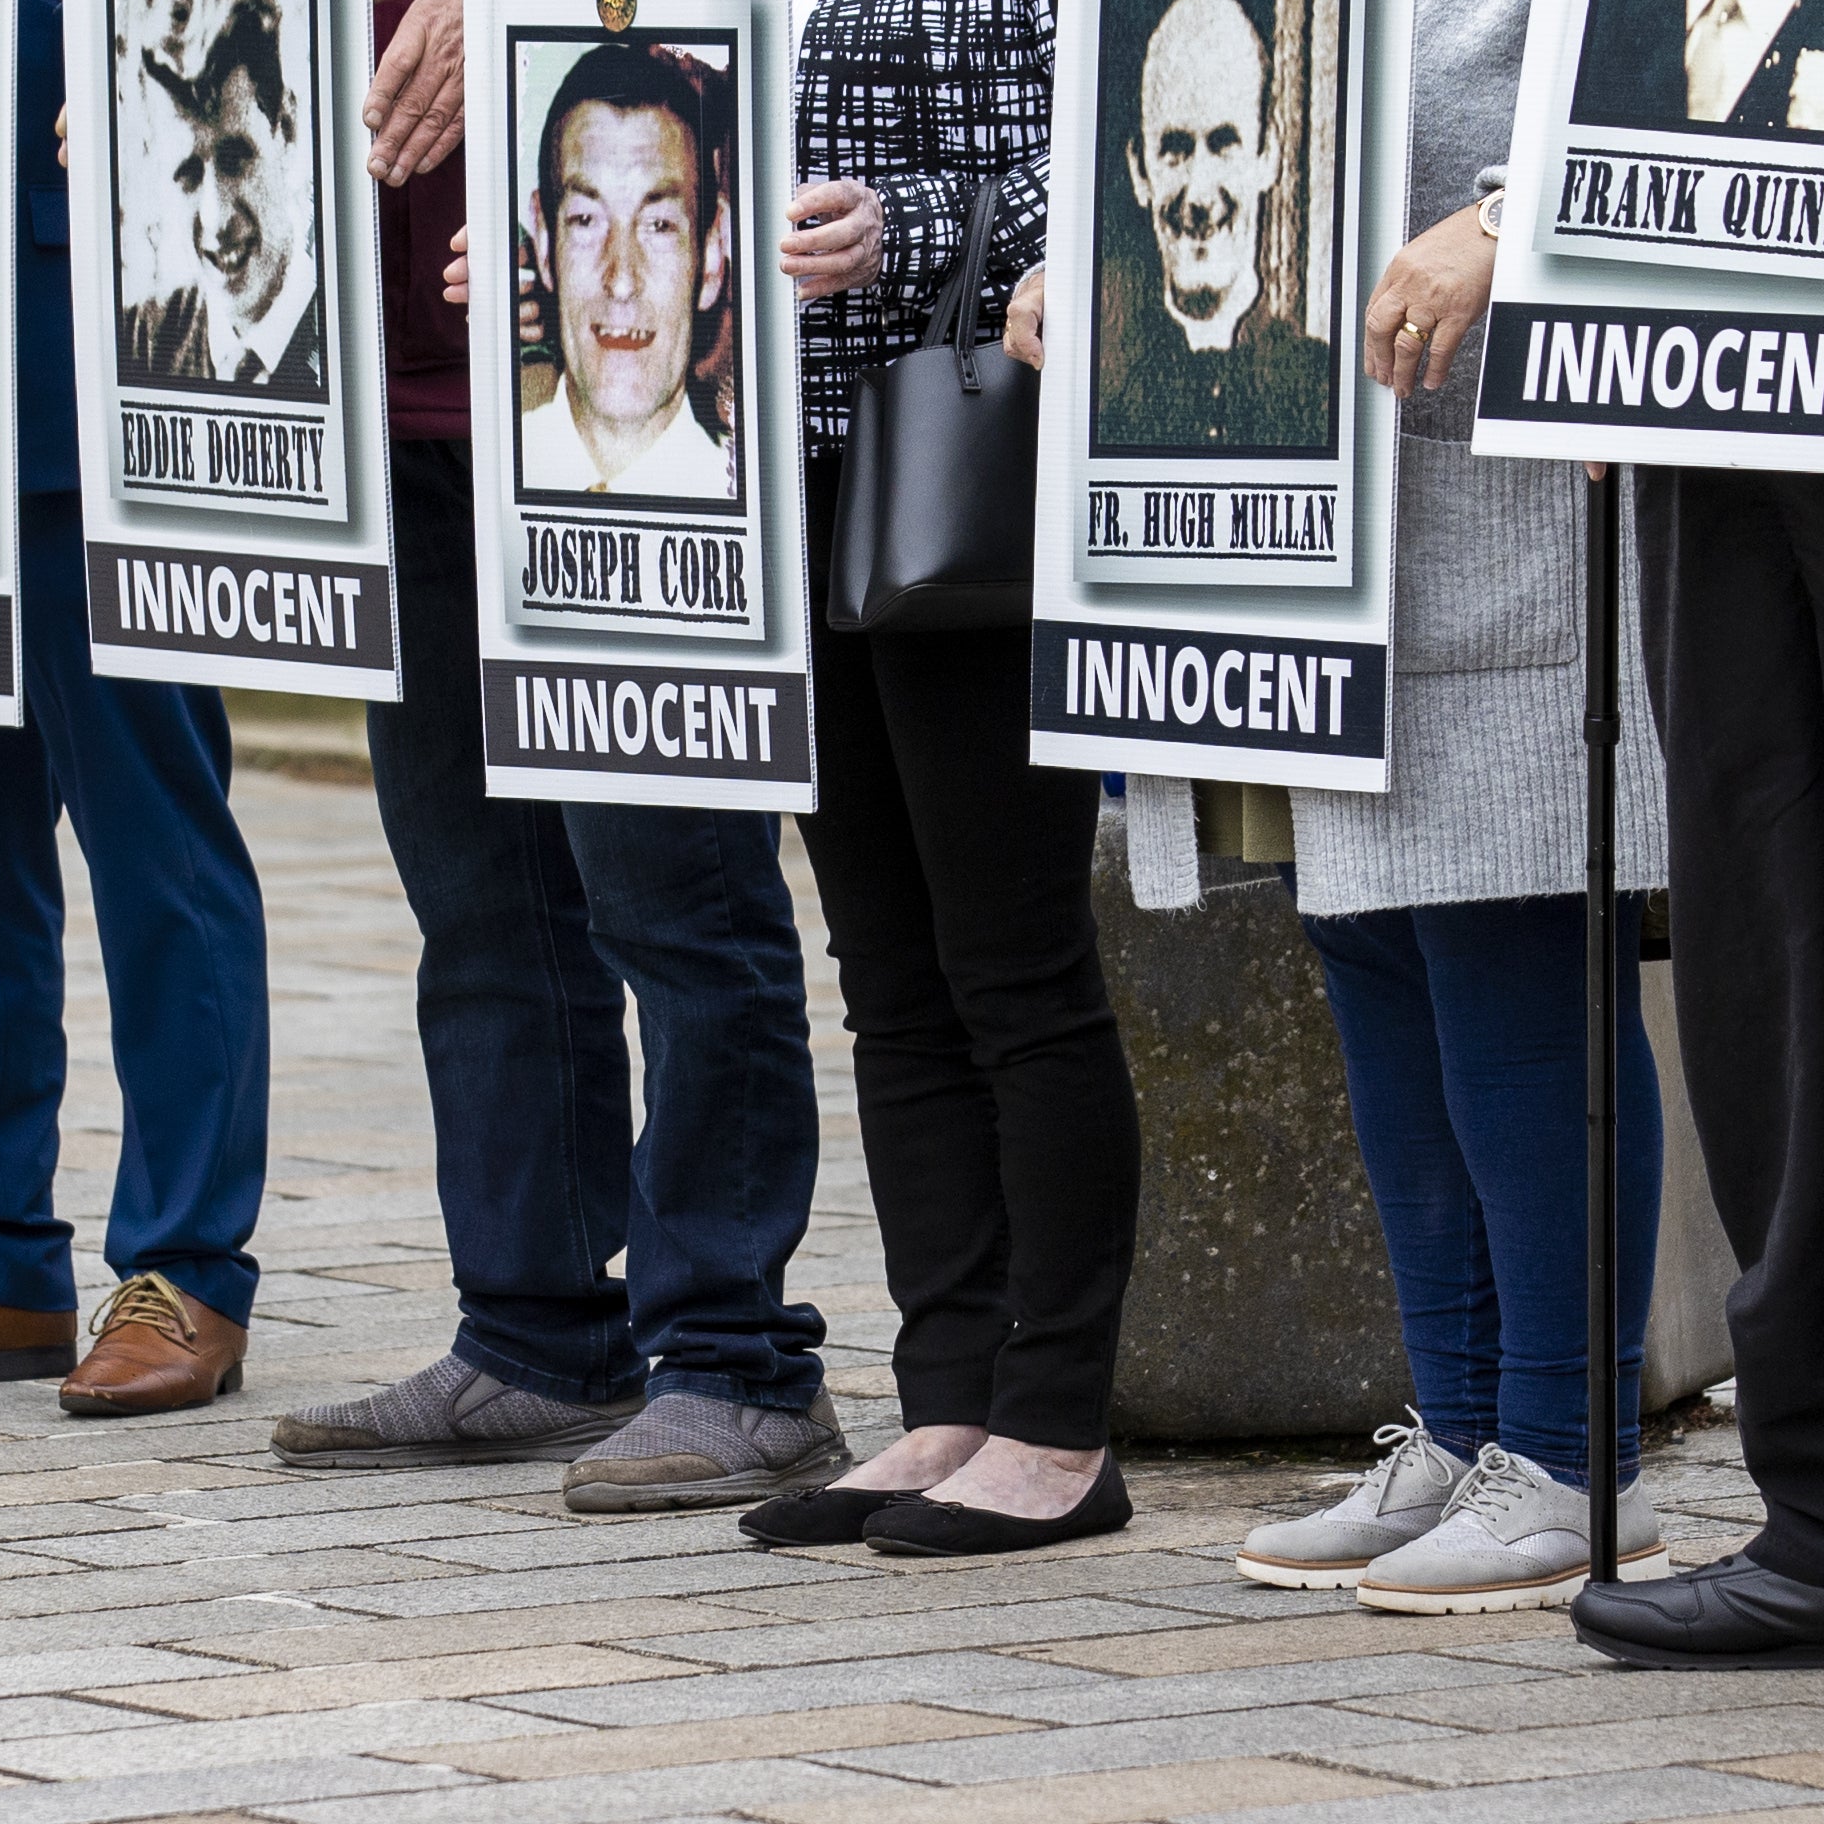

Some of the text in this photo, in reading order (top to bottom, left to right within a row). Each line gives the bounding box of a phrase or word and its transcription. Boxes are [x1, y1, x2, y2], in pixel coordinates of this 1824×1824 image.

[1557, 158, 1705, 234] FRANK
[121, 411, 325, 493] EDDIE DOHERTY
[1088, 491, 1337, 551] FR. HUGH MULLAN
[117, 558, 361, 649] INNOCENT
[522, 526, 748, 613] JOSEPH CORR
[515, 676, 778, 763] INNOCENT
[1066, 638, 1352, 736] INNOCENT
